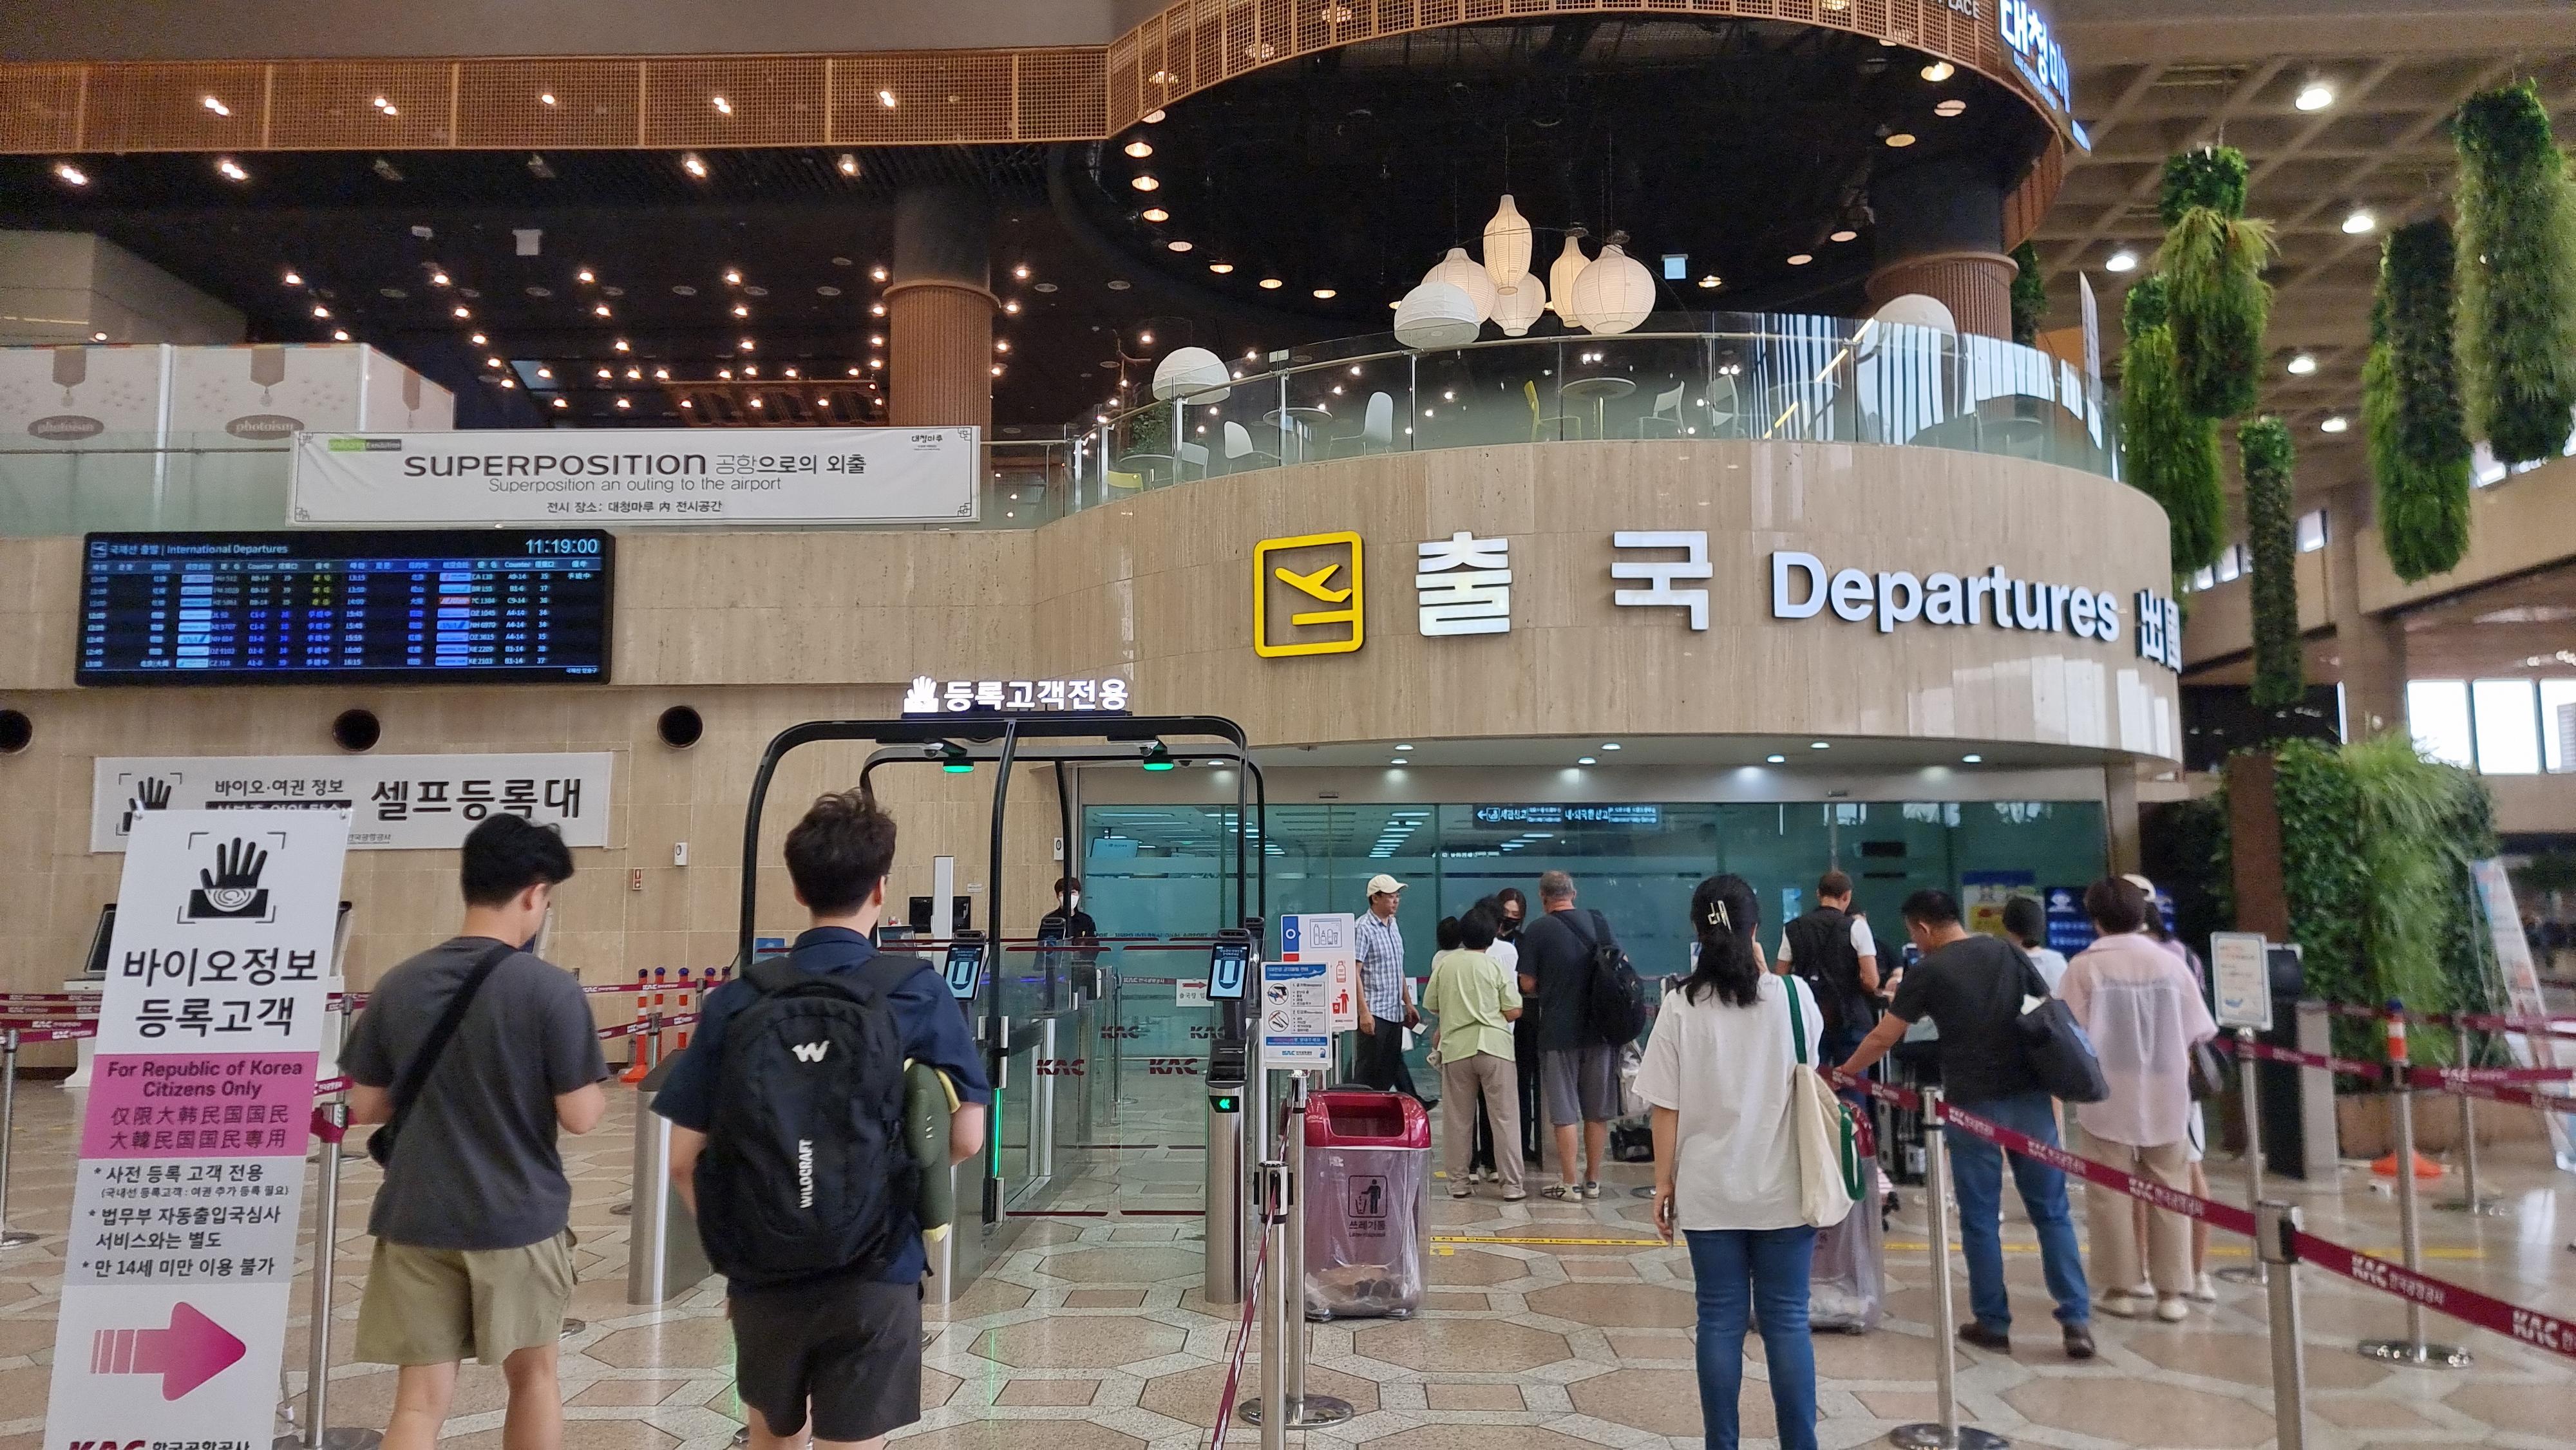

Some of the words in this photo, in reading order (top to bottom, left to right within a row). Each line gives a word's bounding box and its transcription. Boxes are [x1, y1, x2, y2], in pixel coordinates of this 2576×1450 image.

[1938, 0, 1980, 19] LACE
[715, 453, 818, 475] 공항으로의
[826, 453, 867, 475] 외출
[489, 478, 594, 494] Superposition
[601, 480, 620, 491] an
[627, 477, 674, 493] outing
[681, 478, 695, 490] to
[701, 477, 724, 490] the
[731, 476, 781, 492] airport
[547, 502, 570, 513] 전시
[609, 501, 654, 513] 대청마루
[676, 500, 723, 513] 전시공간
[167, 545, 232, 554] International
[233, 545, 289, 555] Departures
[526, 538, 598, 554] 11:19:00
[1771, 550, 2121, 643] Departures
[943, 678, 1129, 711] 등록고객전용
[214, 779, 305, 797] 바이오·여권
[311, 779, 343, 796] 정보
[370, 777, 582, 822] 셀프등록대
[122, 947, 319, 987] 바이오정보
[135, 997, 294, 1038] 등록고객
[107, 1061, 137, 1078] For
[142, 1060, 220, 1080] Republic
[226, 1060, 246, 1076] of
[249, 1060, 302, 1076] Korea
[1036, 1059, 1084, 1075] KAC
[1150, 1059, 1198, 1075] KAC
[143, 1080, 216, 1097] Citizens
[222, 1080, 262, 1099] Only
[106, 1166, 140, 1184] 사전
[146, 1165, 181, 1183] 등록
[187, 1165, 222, 1182] 고객
[229, 1163, 263, 1182] 전용
[798, 1138, 813, 1209] WILDCRAFT
[102, 1208, 152, 1226] 법무부
[158, 1205, 281, 1226] 자동출입국심사
[95, 1231, 182, 1250] 서비스와는
[188, 1230, 222, 1249] 별도
[95, 1259, 111, 1277] 만
[117, 1259, 153, 1277] 14세
[159, 1259, 193, 1277] 미만
[199, 1259, 234, 1277] 이용
[239, 1257, 275, 1277] 불가
